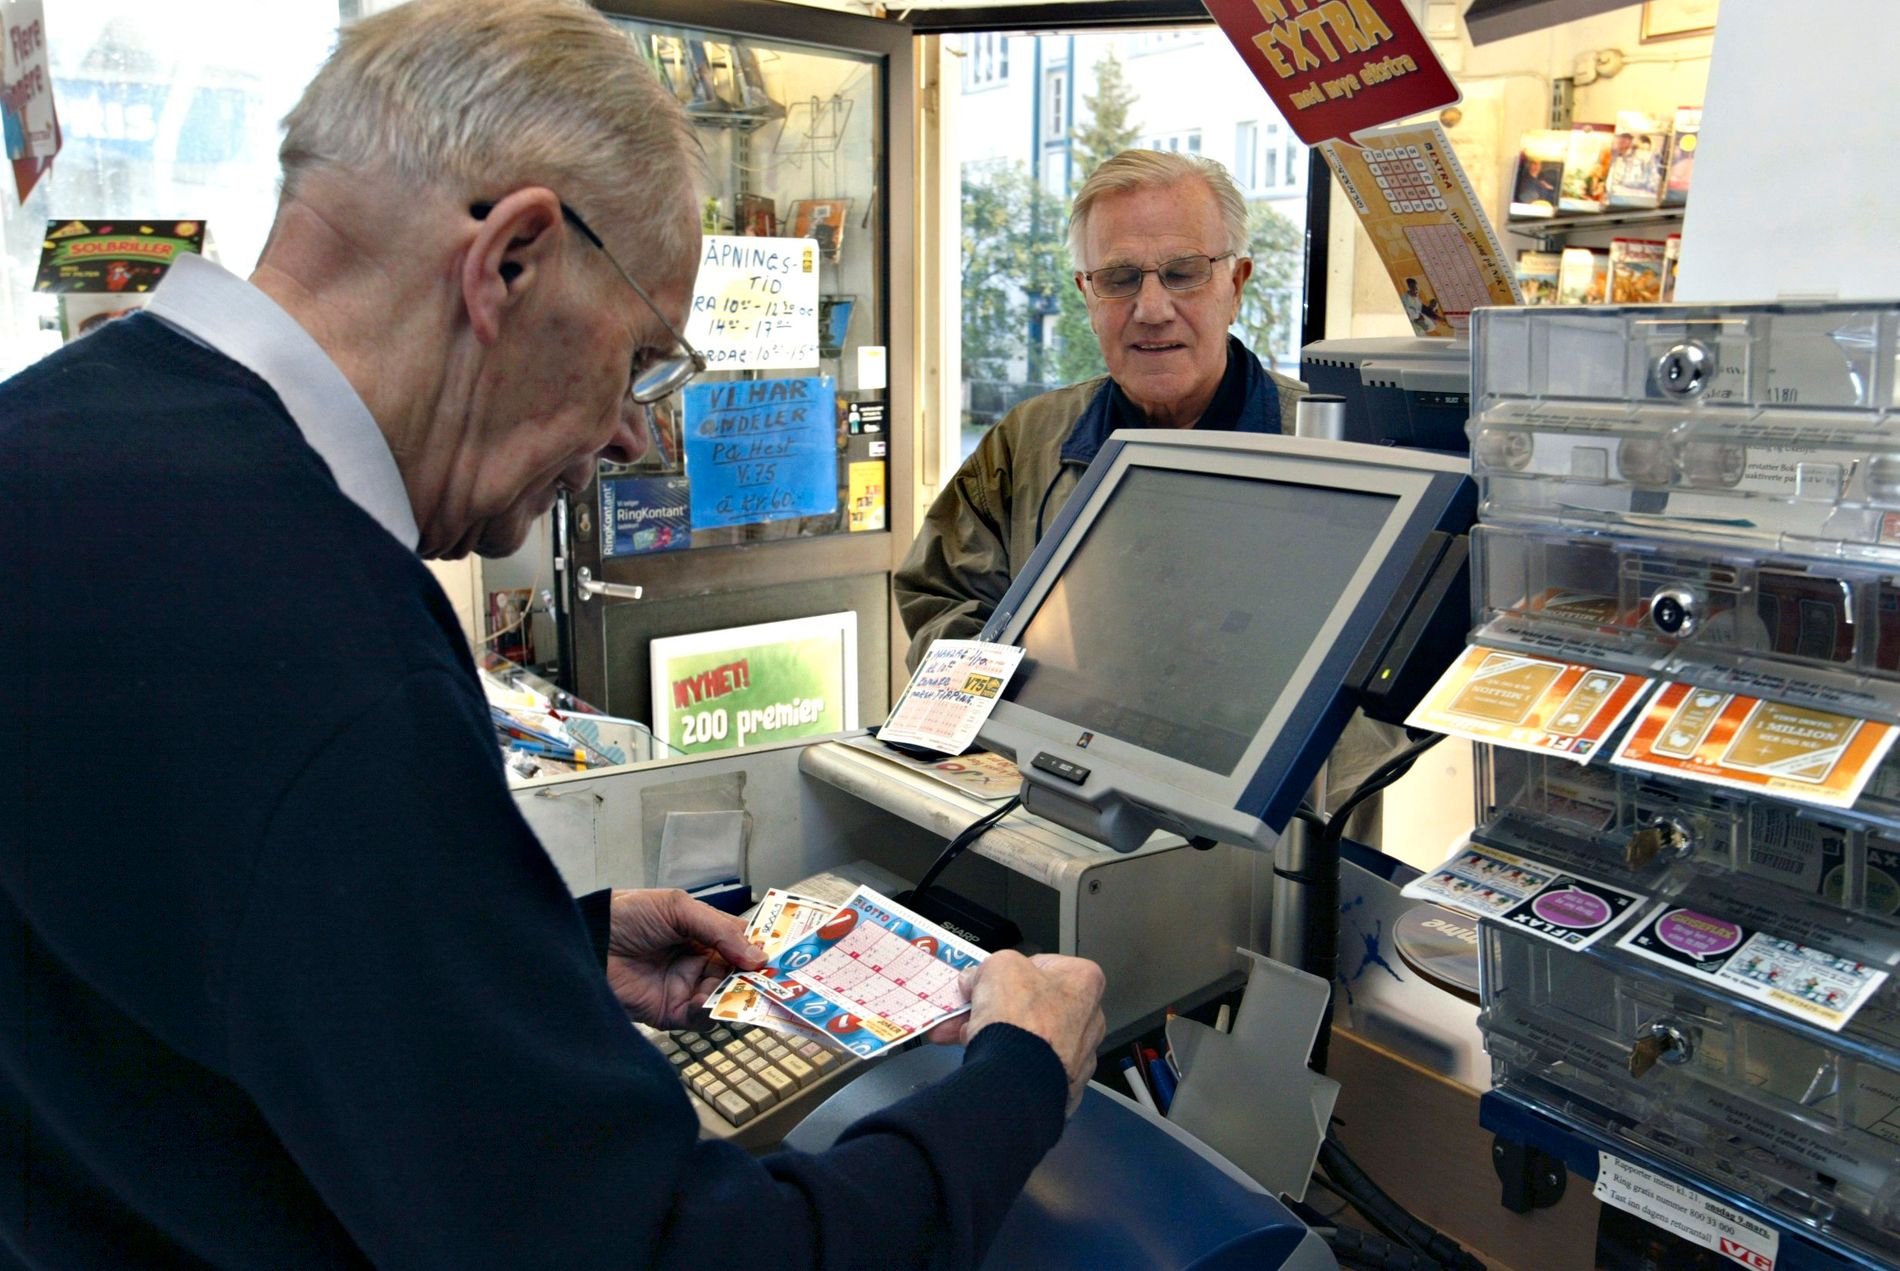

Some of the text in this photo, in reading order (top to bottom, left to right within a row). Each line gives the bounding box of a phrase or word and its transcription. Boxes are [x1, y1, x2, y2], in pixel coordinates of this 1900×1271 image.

[1252, 1, 1393, 78] EXTRA
[1289, 54, 1418, 110] med mye ekstra
[1430, 152, 1453, 189] EXTRA
[70, 239, 173, 255] SOLBRILLER
[693, 296, 716, 312] RA
[710, 380, 809, 409] VI HAR
[603, 484, 614, 556] RingKontant
[617, 505, 687, 522] RingKontant
[672, 658, 750, 709] NYHET!
[963, 677, 986, 692] V75
[682, 698, 825, 748] 200 premier
[1766, 722, 1838, 742] MILLION
[860, 903, 890, 922] LOTTO
[1512, 913, 1566, 938] FLAX
[940, 921, 981, 943] SHARP
[785, 951, 812, 967] 10
[802, 1000, 828, 1015] 10
[877, 1019, 902, 1034] JOKER
[1614, 1158, 1652, 1179] Rapporter
[1653, 1176, 1675, 1192] innen
[1676, 1184, 1687, 1198] kl.
[1704, 1201, 1736, 1222] onsdag
[1610, 1189, 1713, 1243] Tast inn dagens returantall
[1613, 1173, 1736, 1236] Ring gratis nummer 800 33 000
[1721, 1238, 1771, 1269] VG
